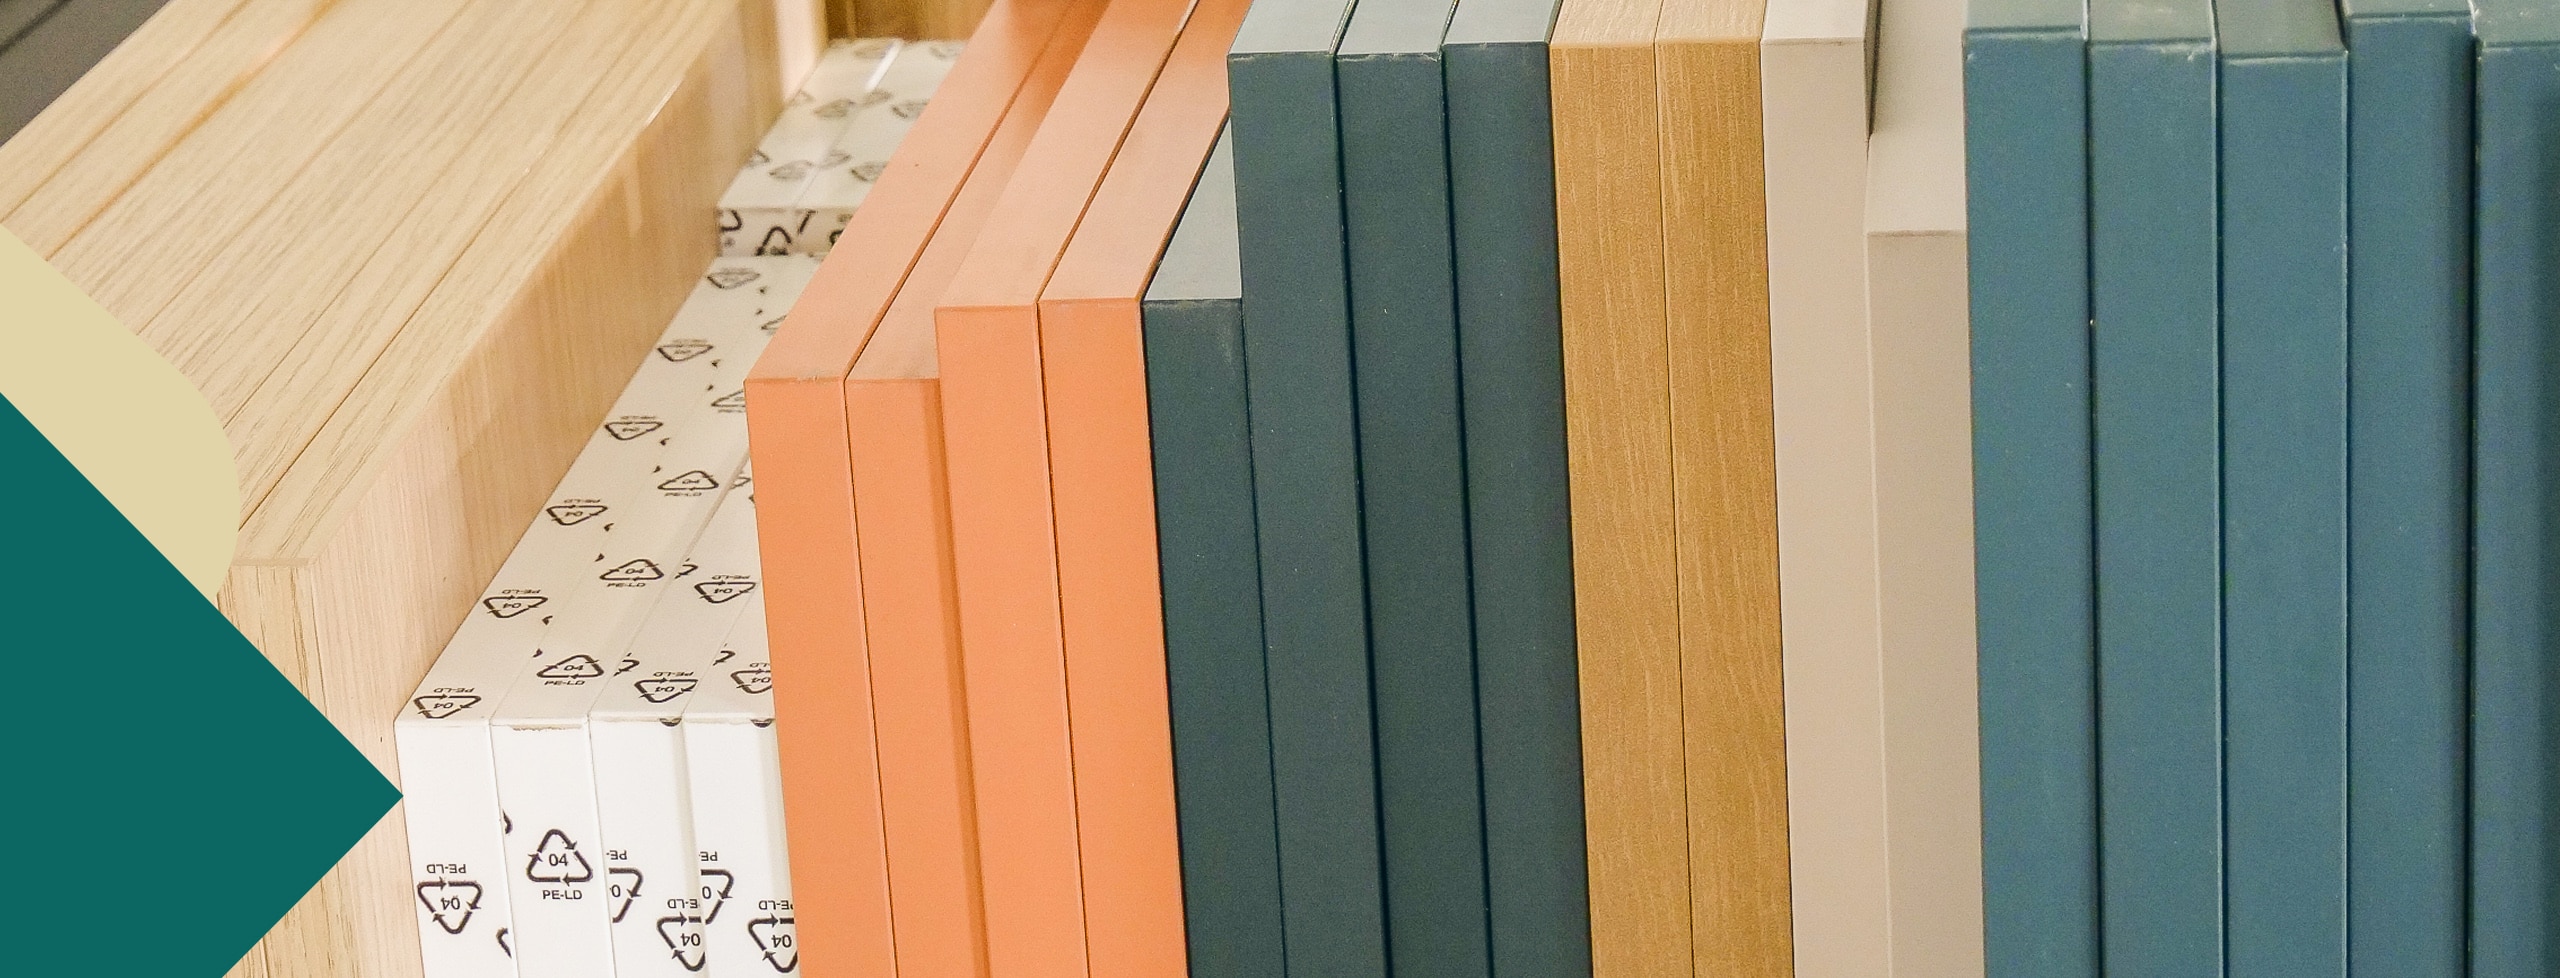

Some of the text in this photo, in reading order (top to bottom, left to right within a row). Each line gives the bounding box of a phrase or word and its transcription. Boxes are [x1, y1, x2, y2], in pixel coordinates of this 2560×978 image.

[548, 853, 569, 866] 04
[426, 864, 466, 874] PE-LD
[542, 890, 583, 901] PE-LD
[440, 897, 460, 910] 04
[668, 898, 700, 909] E-LD
[680, 932, 701, 946] 04
[771, 934, 792, 948] 04
